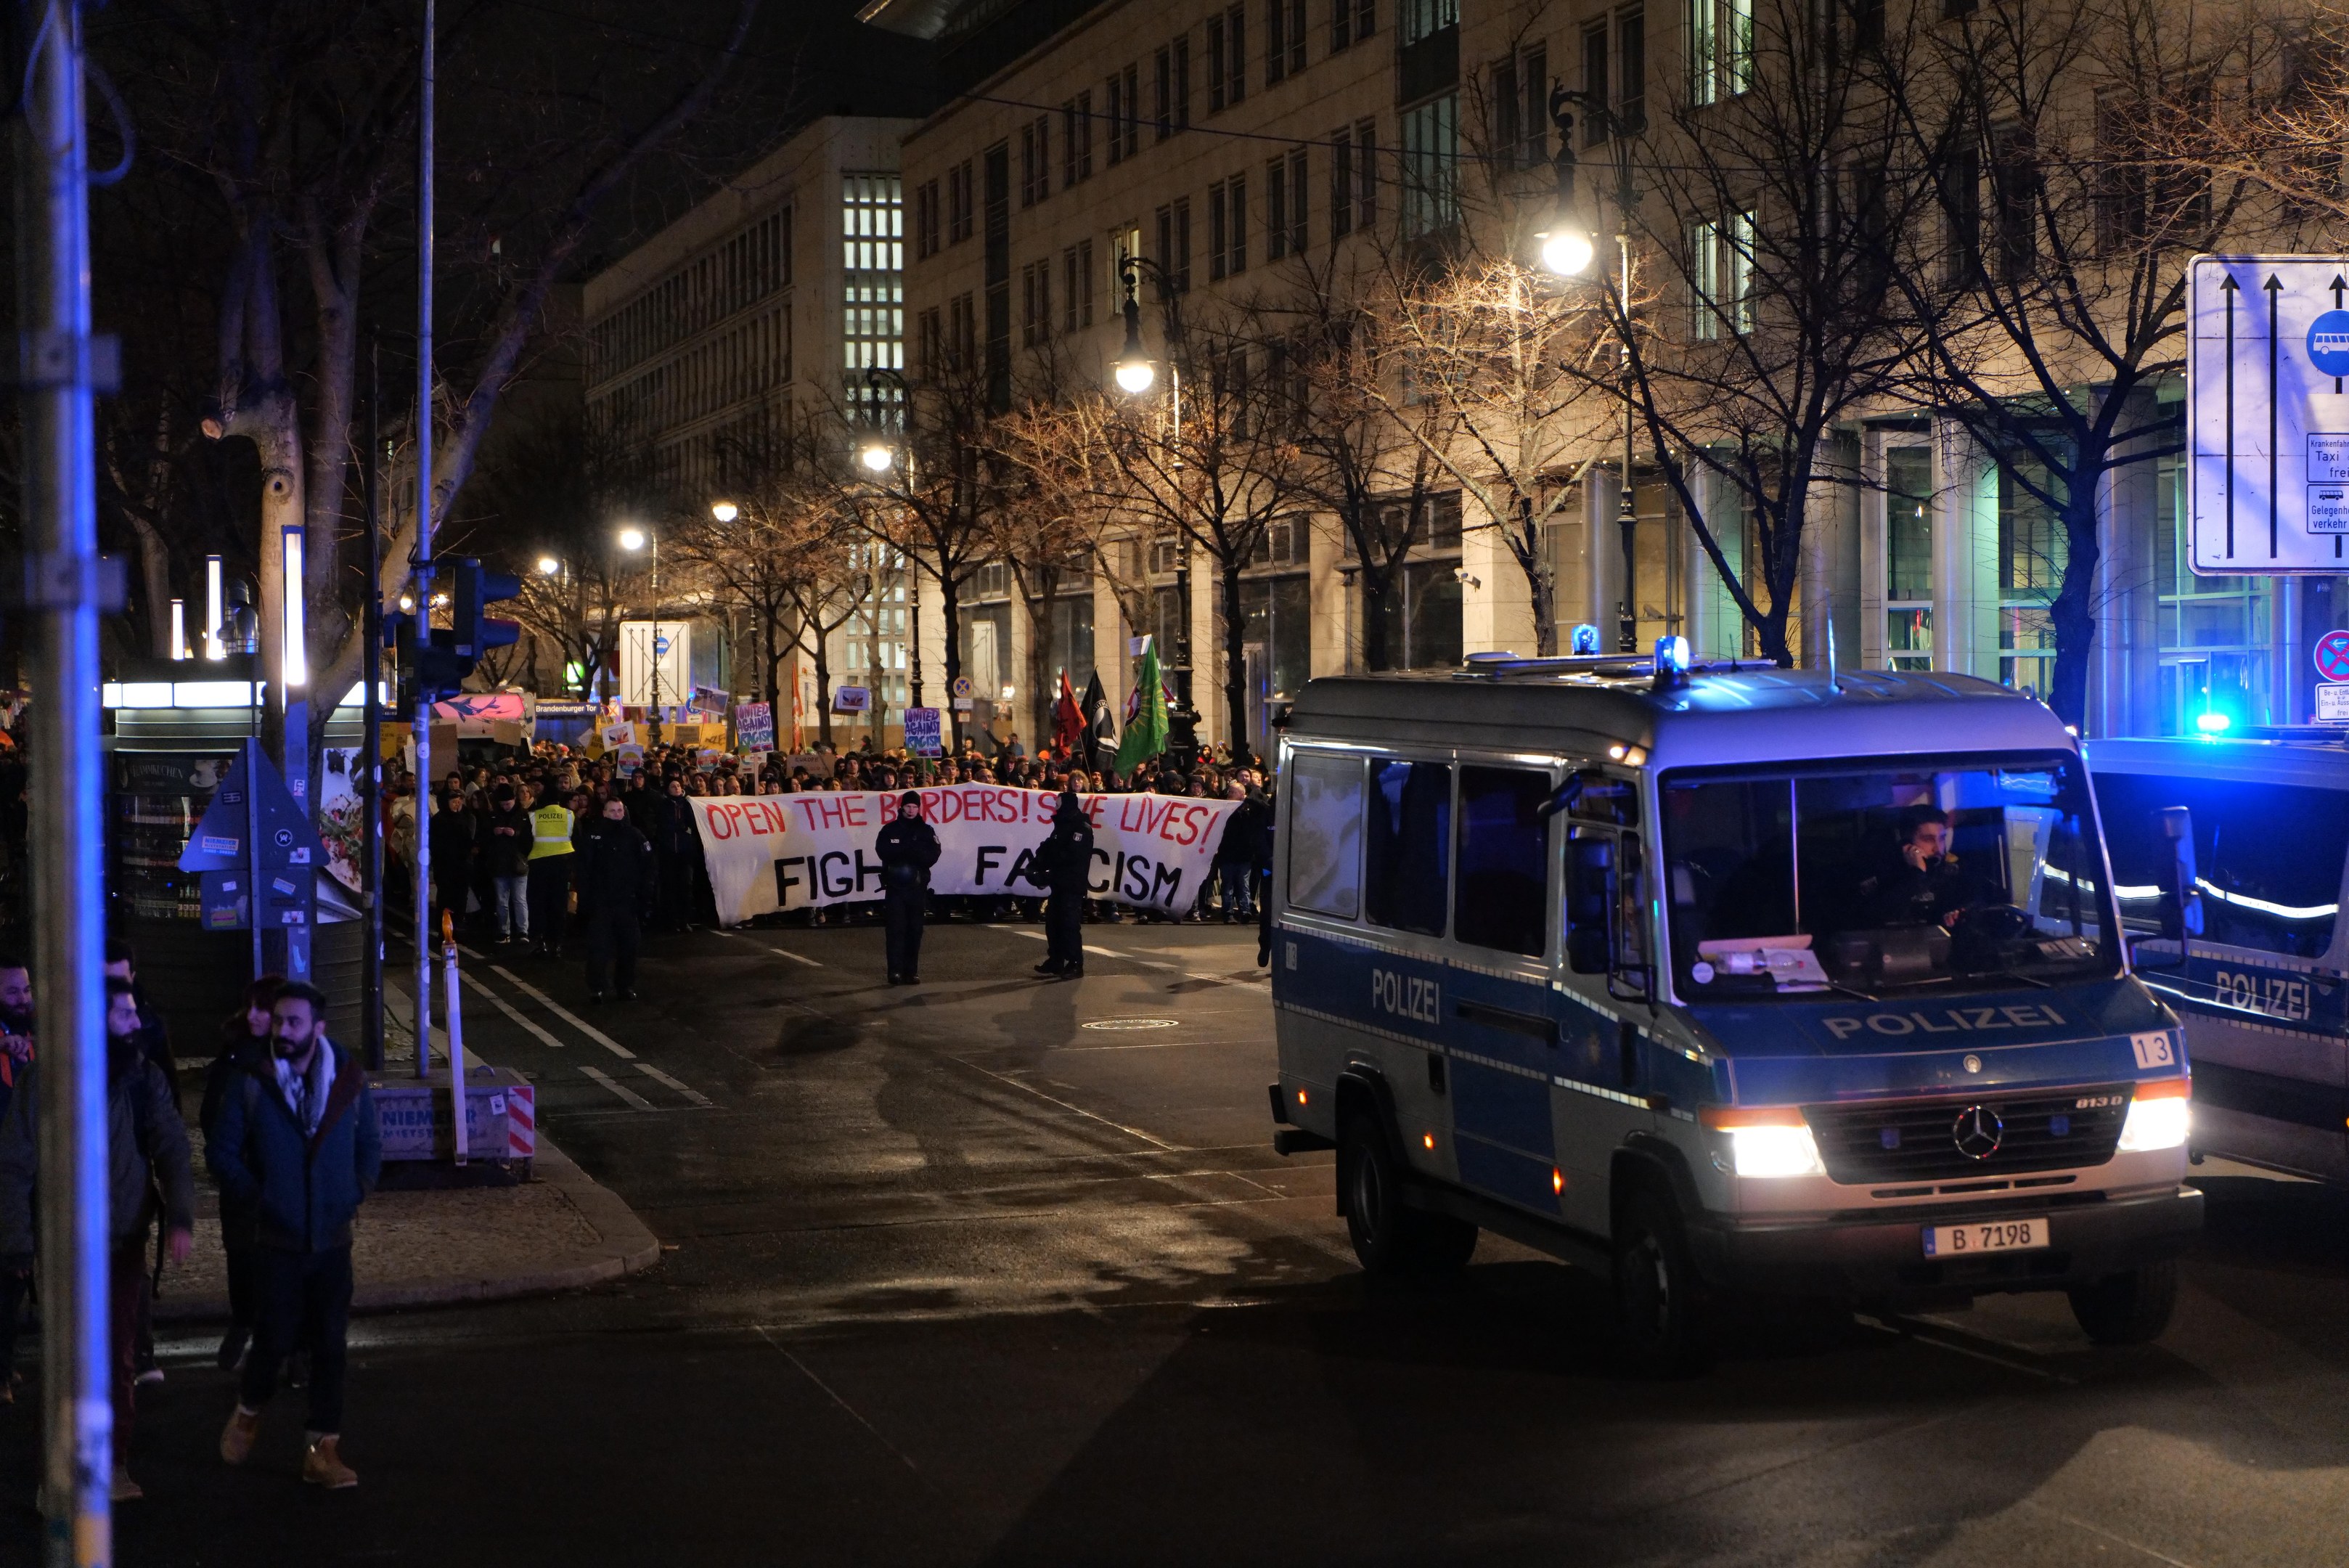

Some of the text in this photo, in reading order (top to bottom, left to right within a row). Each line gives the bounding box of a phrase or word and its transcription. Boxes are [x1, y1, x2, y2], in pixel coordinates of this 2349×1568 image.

[2316, 450, 2339, 461] Taxi
[2313, 518, 2348, 528] verkehr
[737, 716, 772, 732] AGAINST
[905, 721, 940, 735] AGAINST
[739, 730, 774, 746] RACISM
[907, 735, 941, 748] RACISM
[706, 801, 785, 840] OPEN
[793, 795, 867, 831] THE
[1120, 797, 1220, 854] LIVES!
[774, 845, 1182, 907] FIGH FACISM
[1373, 968, 1440, 1025] POLIZEI
[2215, 971, 2311, 1021] POLIZEI
[1822, 1004, 2066, 1040] POLIZEI
[2137, 1037, 2168, 1063] 13
[1953, 1222, 2031, 1250] B 7198
